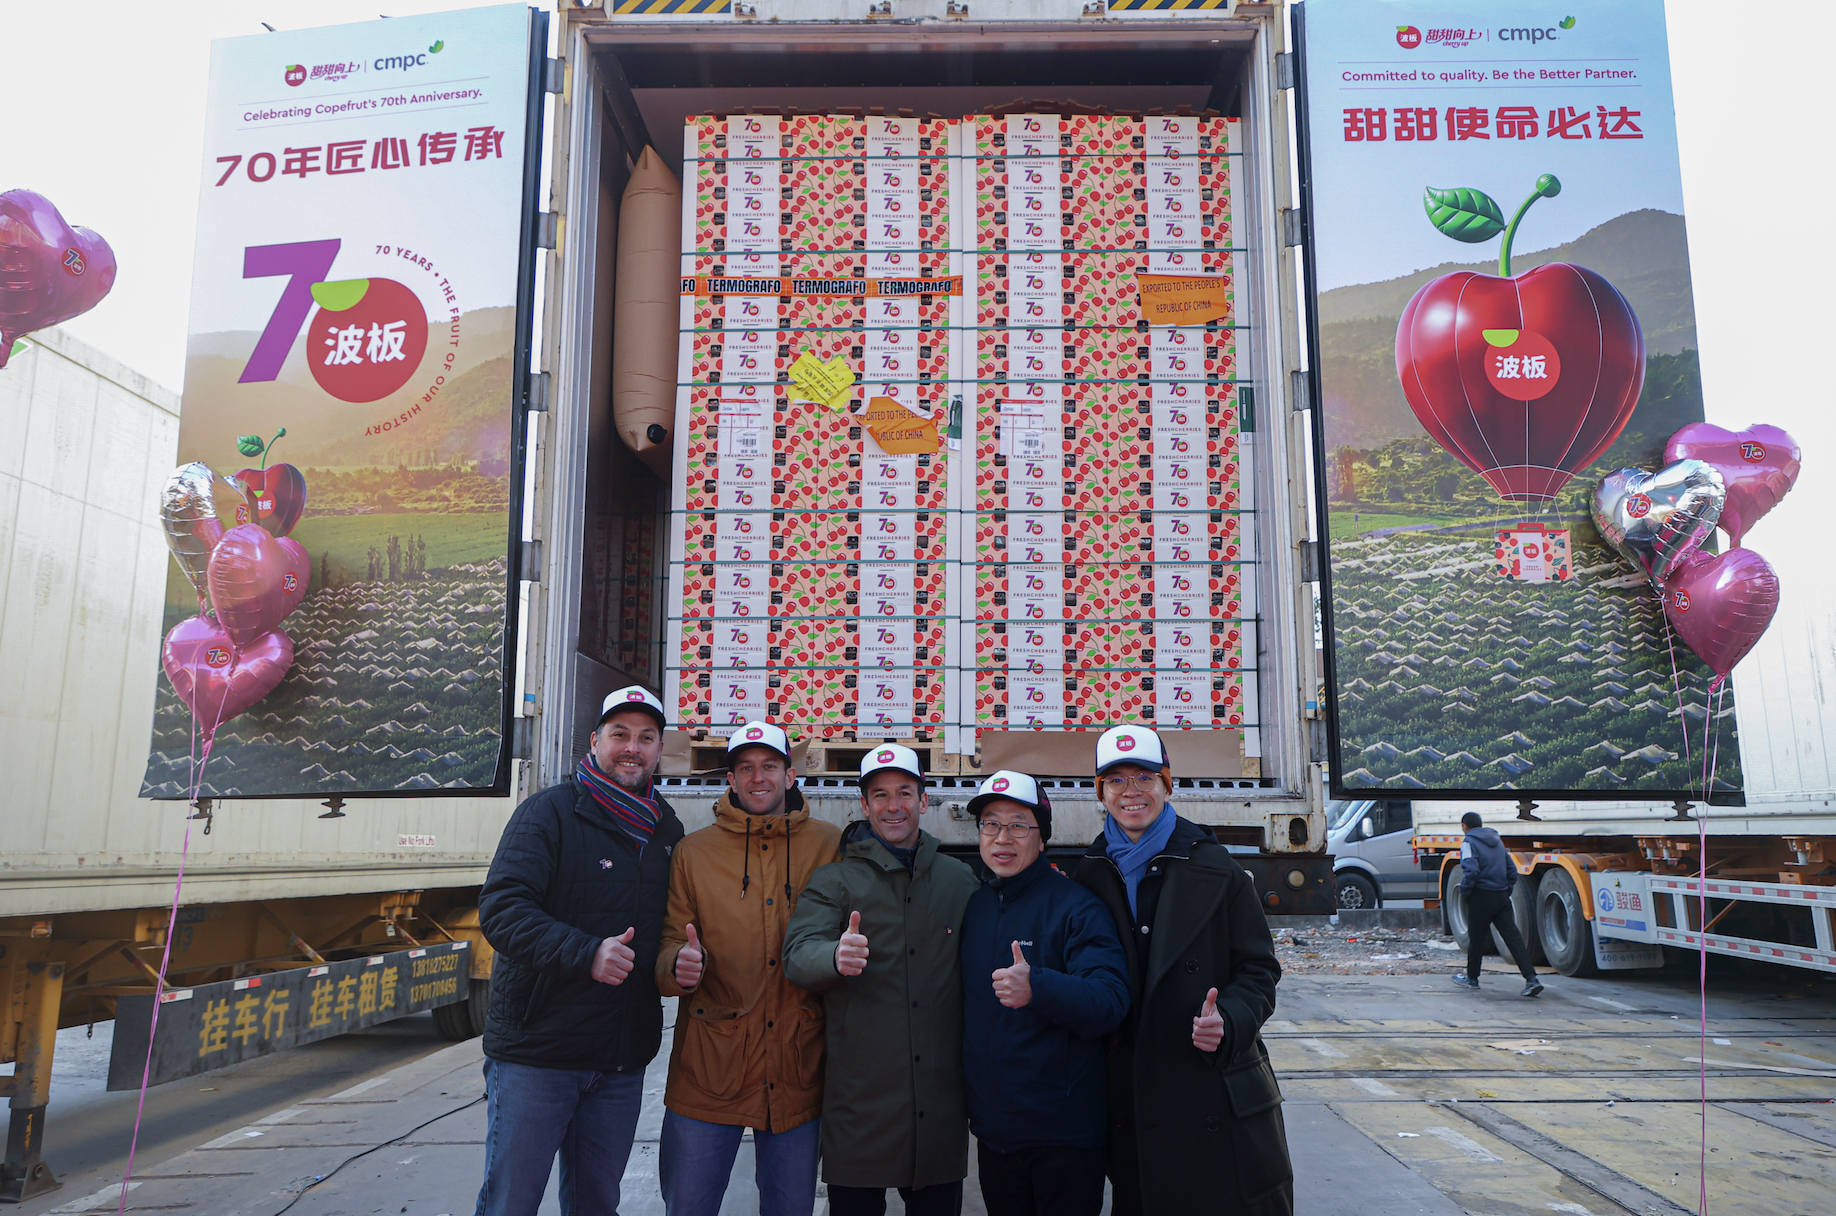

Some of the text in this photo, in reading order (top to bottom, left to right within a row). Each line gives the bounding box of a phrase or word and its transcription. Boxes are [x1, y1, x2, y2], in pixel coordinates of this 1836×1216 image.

[1426, 28, 1482, 44] 甜甜向上
[1498, 28, 1557, 44] cmpc
[374, 54, 426, 72] cmpc
[1342, 68, 1637, 82] Committed to quality. Be the Better Partner.
[244, 88, 482, 122] Celebrating Copefrut's 70th Anniversary.
[1343, 106, 1644, 142] 甜甜使命必达
[215, 126, 505, 186] 70年匠心传承
[707, 277, 781, 293] TERMÓGRAFO
[792, 278, 866, 294] TERMÓGRAFO
[878, 279, 952, 295] TERMÓGRAFO
[1142, 279, 1220, 293] EXPORTED TO THE PEOPLE'S
[1156, 300, 1211, 313] REPUBLIC OF CHINA
[324, 320, 407, 366] 波板
[364, 245, 460, 436] 70 YEARS THE FRUIT OF OUR HISTORY
[1495, 354, 1548, 379] 波板
[886, 411, 894, 420] TO
[896, 410, 906, 419] THE
[896, 431, 904, 440] OF
[905, 430, 924, 440] CHINA
[1616, 892, 1642, 911] 骏通
[199, 966, 398, 1058] 挂车行 挂车租赁
